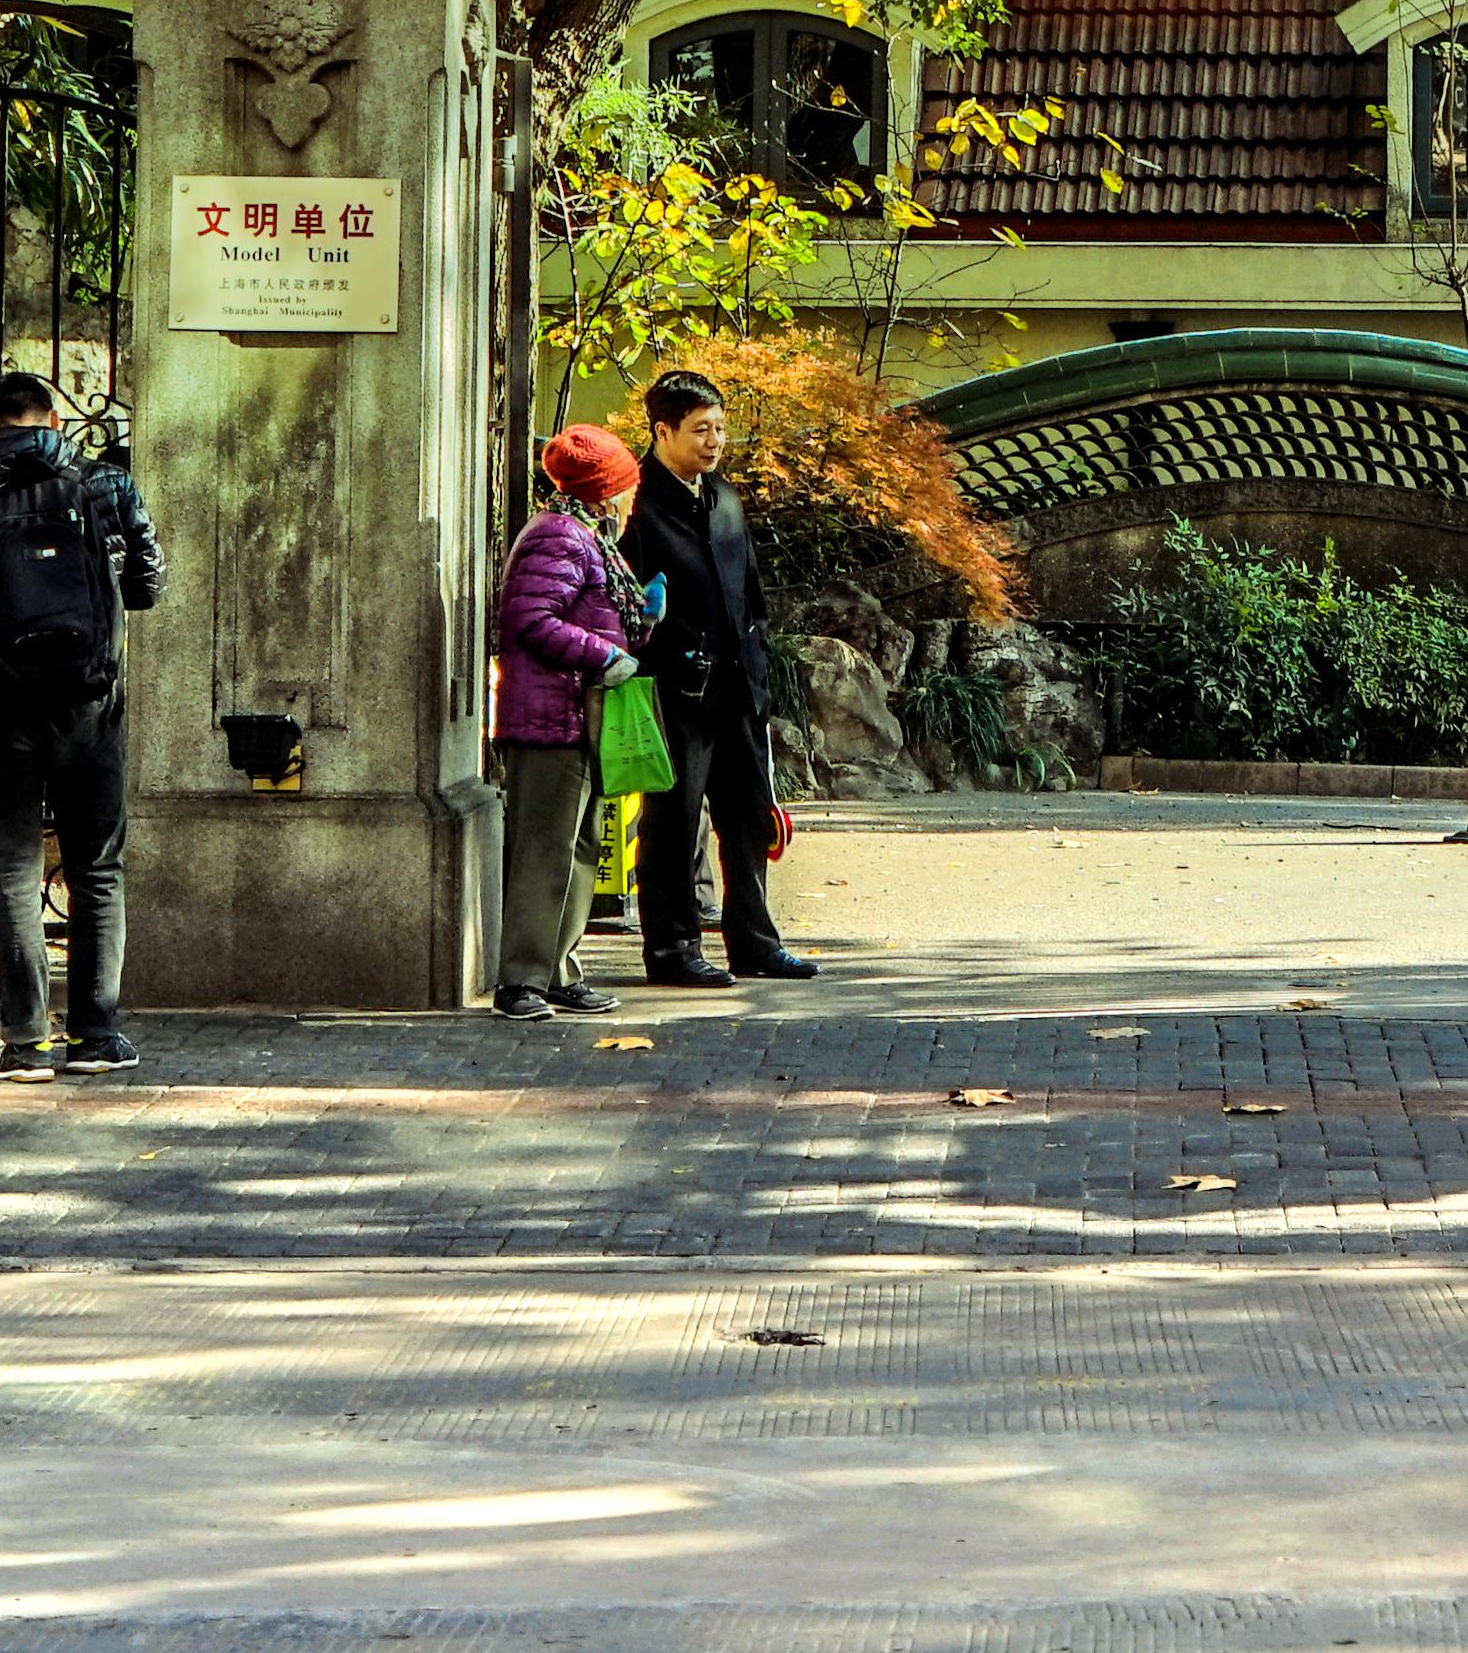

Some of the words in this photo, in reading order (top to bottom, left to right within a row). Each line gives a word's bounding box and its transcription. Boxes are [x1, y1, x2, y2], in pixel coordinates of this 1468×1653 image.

[196, 202, 375, 239] 文明单位
[220, 246, 280, 262] Model
[308, 247, 350, 263] Unit
[218, 277, 350, 292] 上海市人民政府颁发
[259, 295, 291, 304] Issued
[296, 295, 307, 306] by
[221, 307, 269, 317] Shanghai
[279, 307, 343, 319] Municipality
